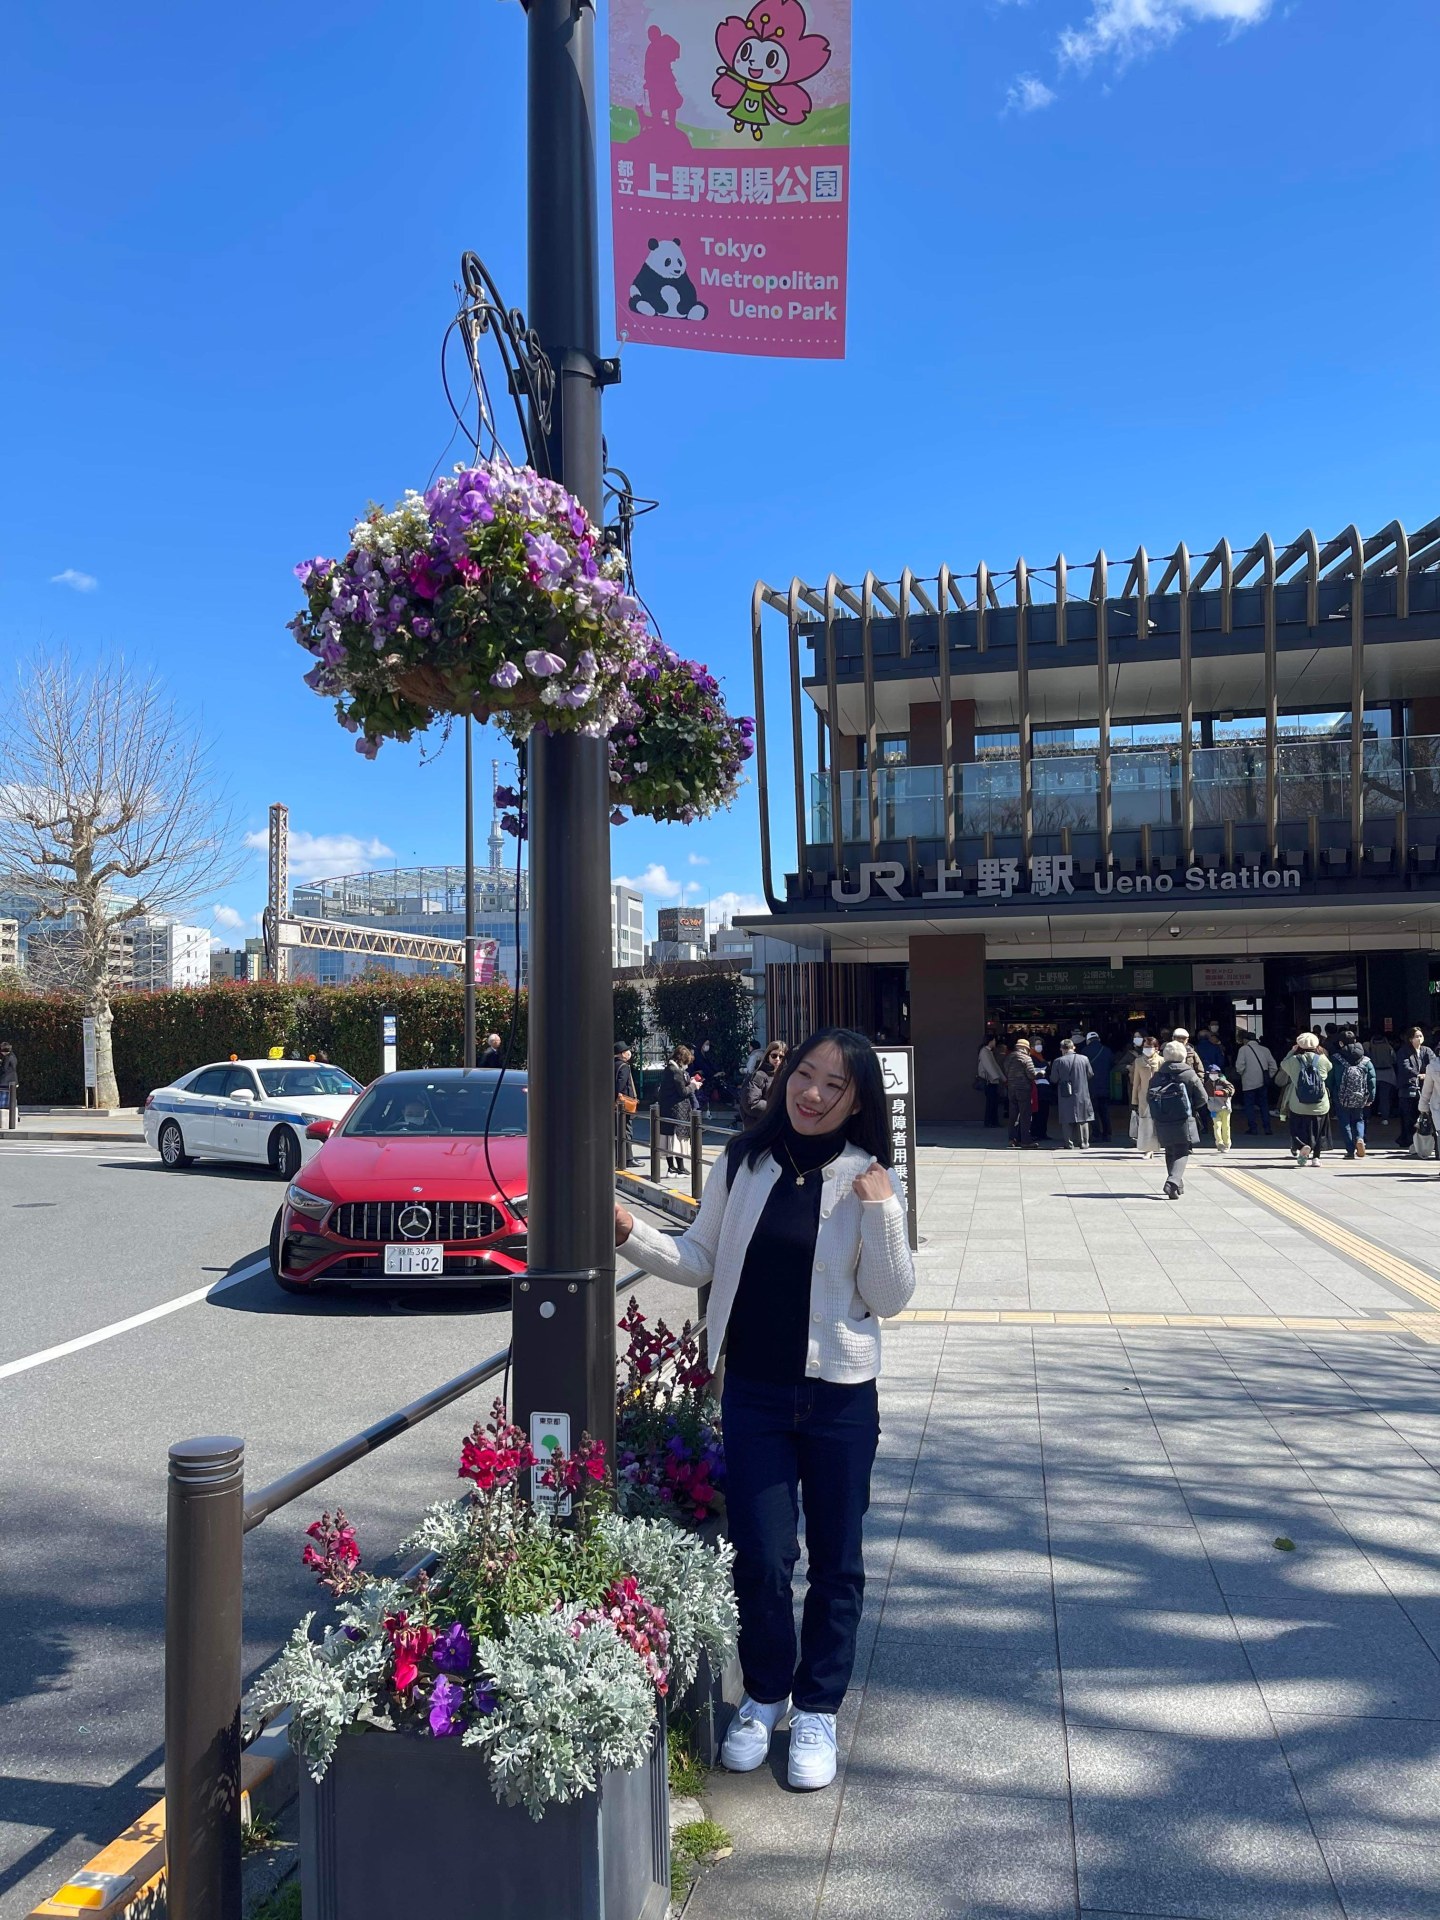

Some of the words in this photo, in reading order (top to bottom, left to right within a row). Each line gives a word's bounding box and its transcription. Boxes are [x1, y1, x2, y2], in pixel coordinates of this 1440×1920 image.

[618, 160, 634, 195] 都立
[638, 163, 843, 205] 上野恩賜公園
[700, 237, 766, 262] Tokyo
[700, 268, 838, 294] Metropolitan
[730, 299, 783, 319] Ueno
[788, 301, 837, 320] Park
[832, 861, 905, 904] JR
[922, 855, 1074, 900] 上野駅
[1094, 870, 1173, 895] Ueno
[1185, 866, 1301, 891] Station
[1004, 972, 1029, 987] JR
[1035, 971, 1069, 983] 上野駅
[892, 1098, 909, 1211] 身障者用乗
[400, 1257, 439, 1271] 11-02
